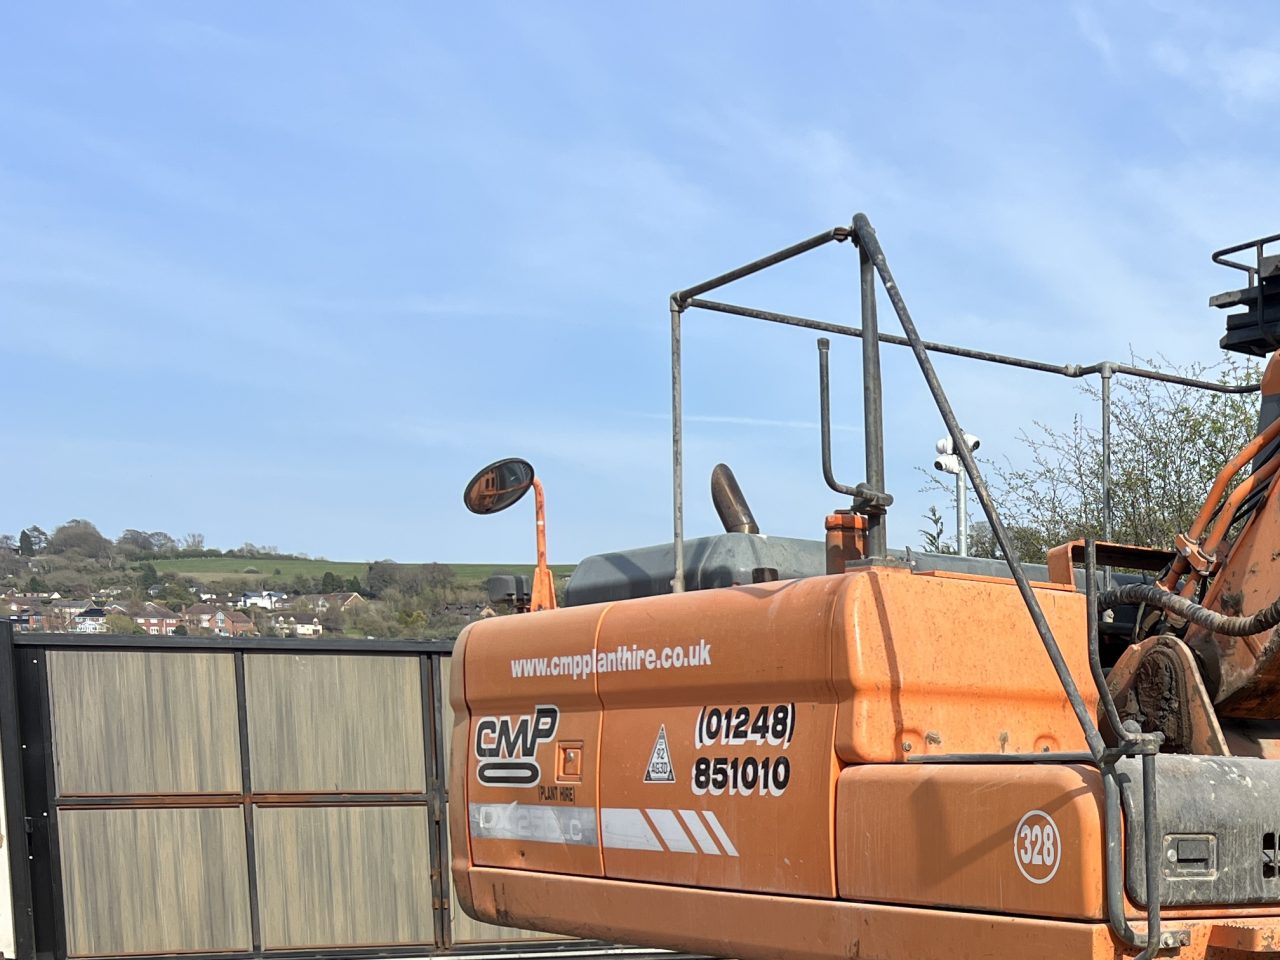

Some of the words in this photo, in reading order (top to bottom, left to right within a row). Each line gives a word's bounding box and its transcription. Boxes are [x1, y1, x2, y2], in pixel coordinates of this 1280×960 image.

[511, 639, 711, 680] www.cmpplanthire.co.uk
[475, 704, 559, 760] CMP
[695, 702, 796, 750] (01248)
[691, 756, 791, 797] 851010
[1020, 824, 1055, 866] 328
